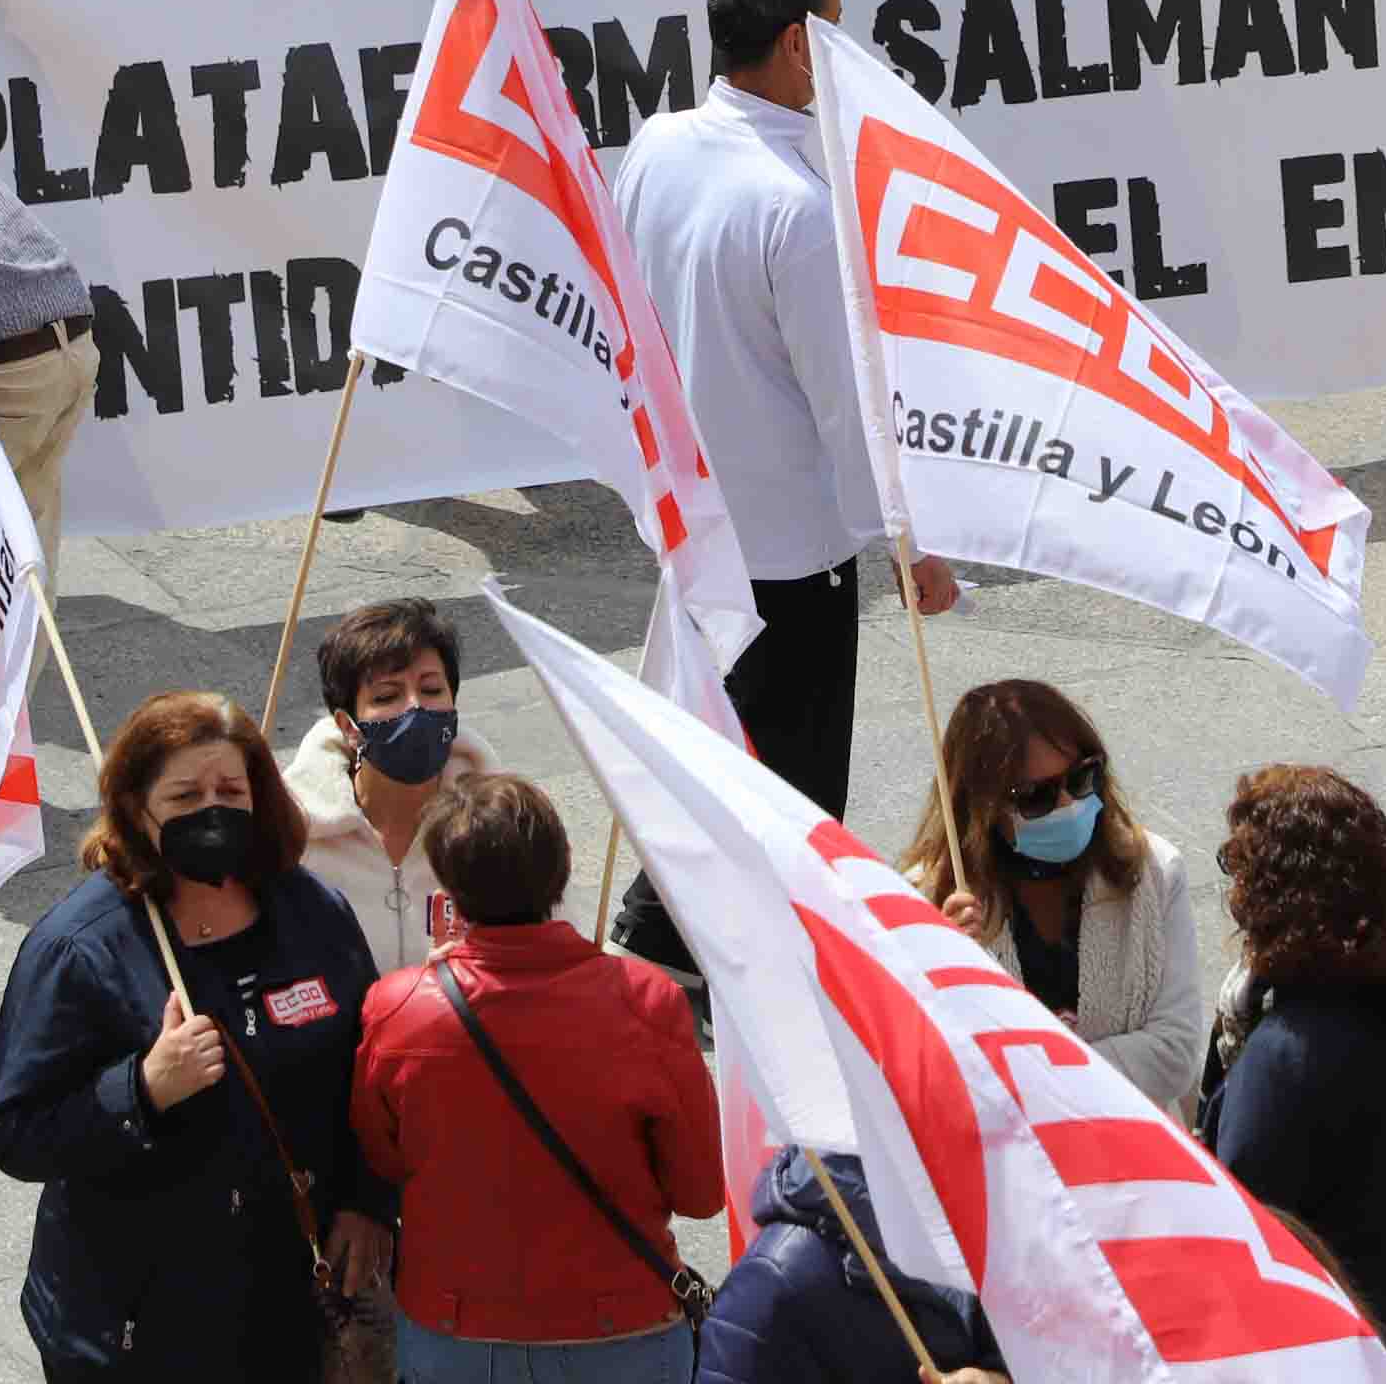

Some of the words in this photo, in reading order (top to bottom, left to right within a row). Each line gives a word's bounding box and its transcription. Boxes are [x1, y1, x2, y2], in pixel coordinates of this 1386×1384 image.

[425, 216, 613, 373] Castilla
[892, 391, 1076, 478] Castilla
[1088, 456, 1136, 504] y
[1151, 469, 1298, 580] León
